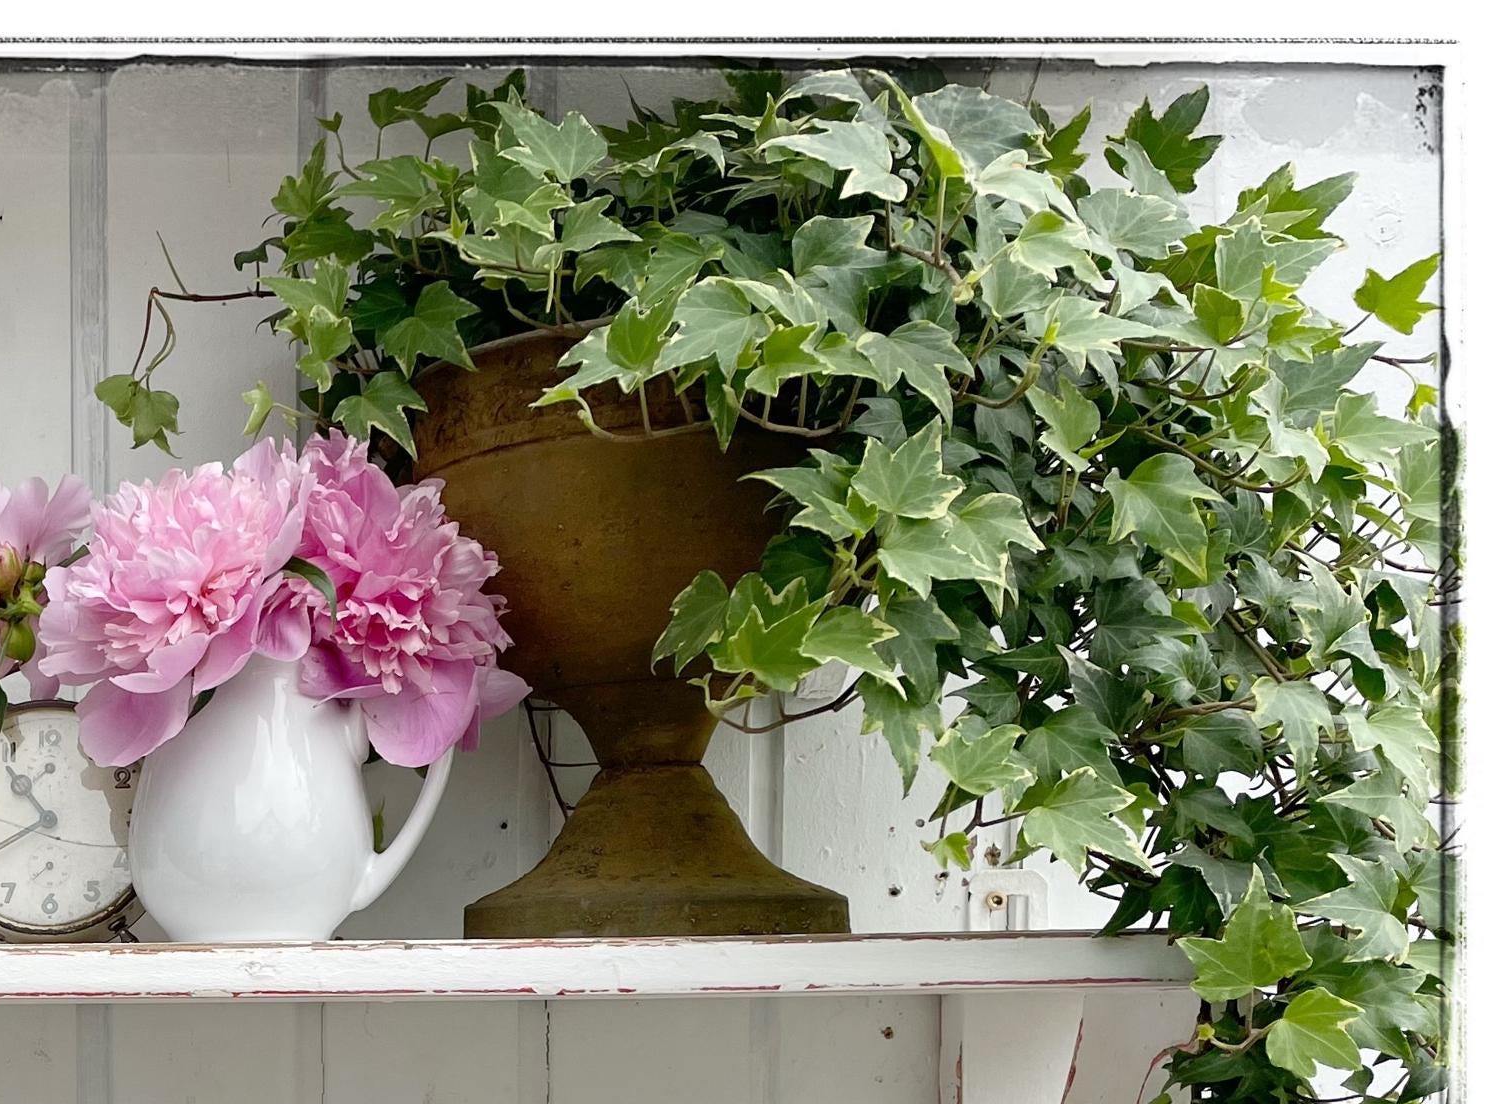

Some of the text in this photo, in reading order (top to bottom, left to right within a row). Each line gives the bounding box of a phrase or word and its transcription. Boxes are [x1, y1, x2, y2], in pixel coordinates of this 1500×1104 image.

[38, 728, 62, 748] 12
[2, 741, 17, 763] 11
[113, 766, 131, 788] 2
[112, 851, 130, 872] 4
[0, 882, 17, 904] 7
[83, 880, 100, 902] 5
[41, 892, 59, 914] 6
